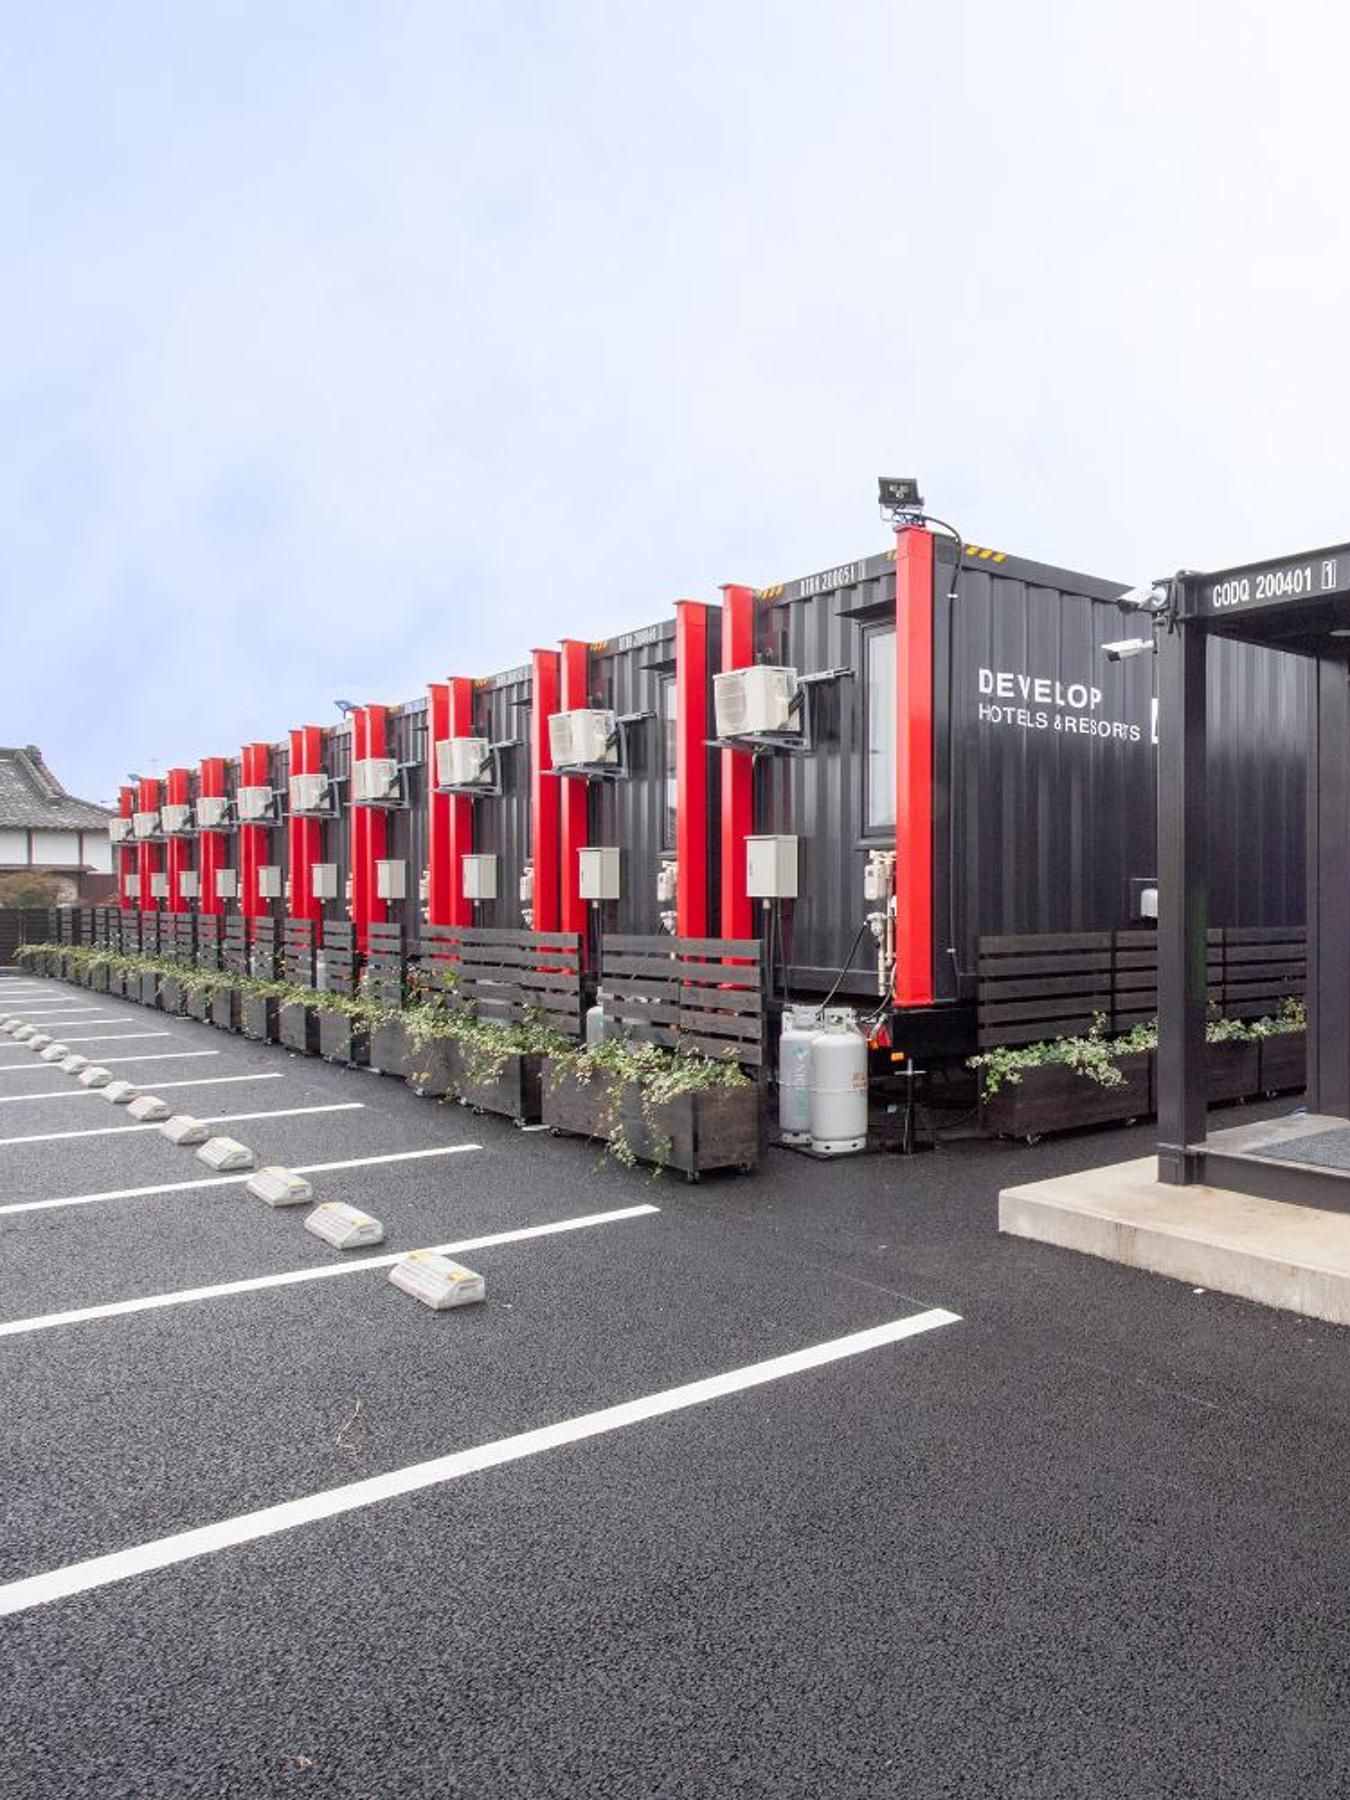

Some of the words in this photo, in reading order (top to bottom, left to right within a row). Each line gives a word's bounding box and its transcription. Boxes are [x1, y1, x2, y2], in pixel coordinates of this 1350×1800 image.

[1213, 578, 1250, 608] CODQ
[1255, 566, 1312, 600] 200401
[978, 668, 1103, 710] DEVELOP
[978, 703, 1048, 728] HOTELS
[1064, 716, 1141, 742] RESORTS
